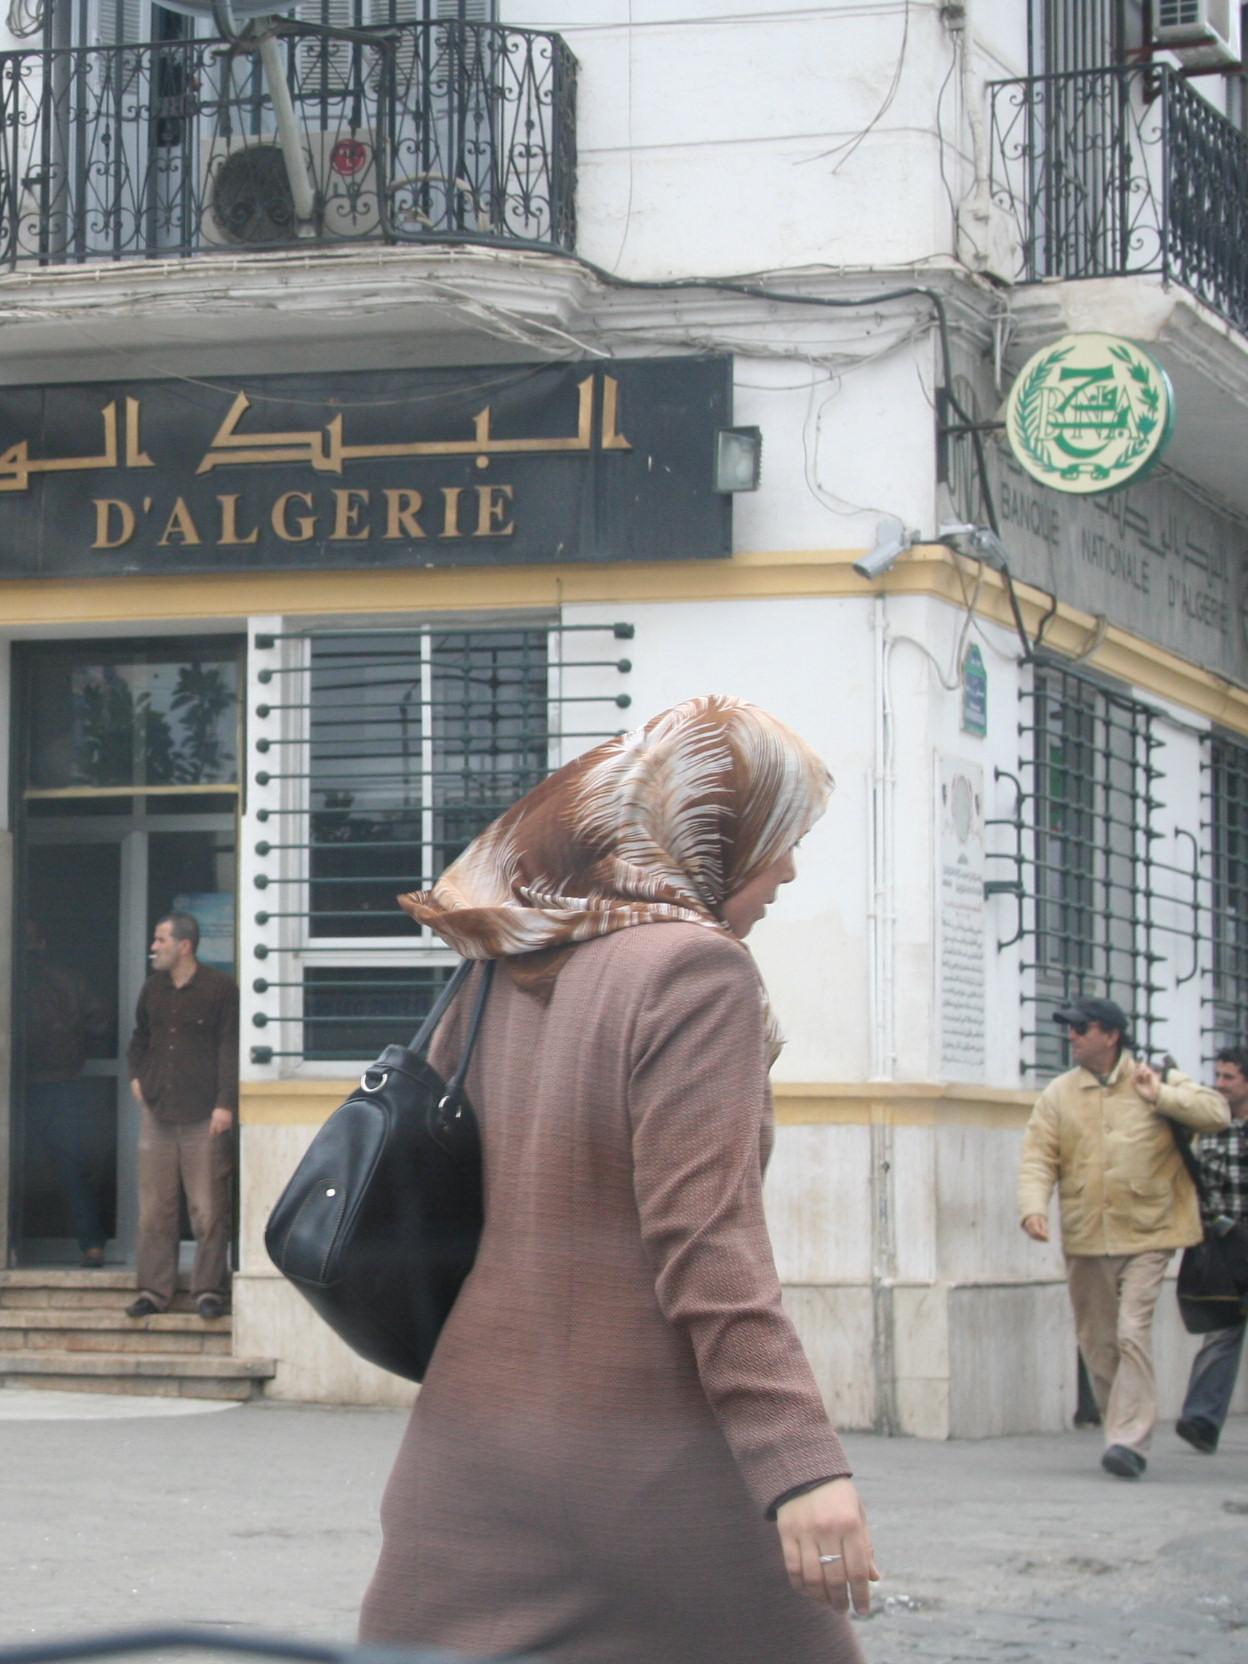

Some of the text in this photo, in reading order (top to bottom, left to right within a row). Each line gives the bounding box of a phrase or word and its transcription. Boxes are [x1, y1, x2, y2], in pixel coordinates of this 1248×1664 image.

[195, 374, 632, 475] البنك
[91, 484, 515, 548] D'ALGERIE
[1000, 480, 1060, 547] BANQUE
